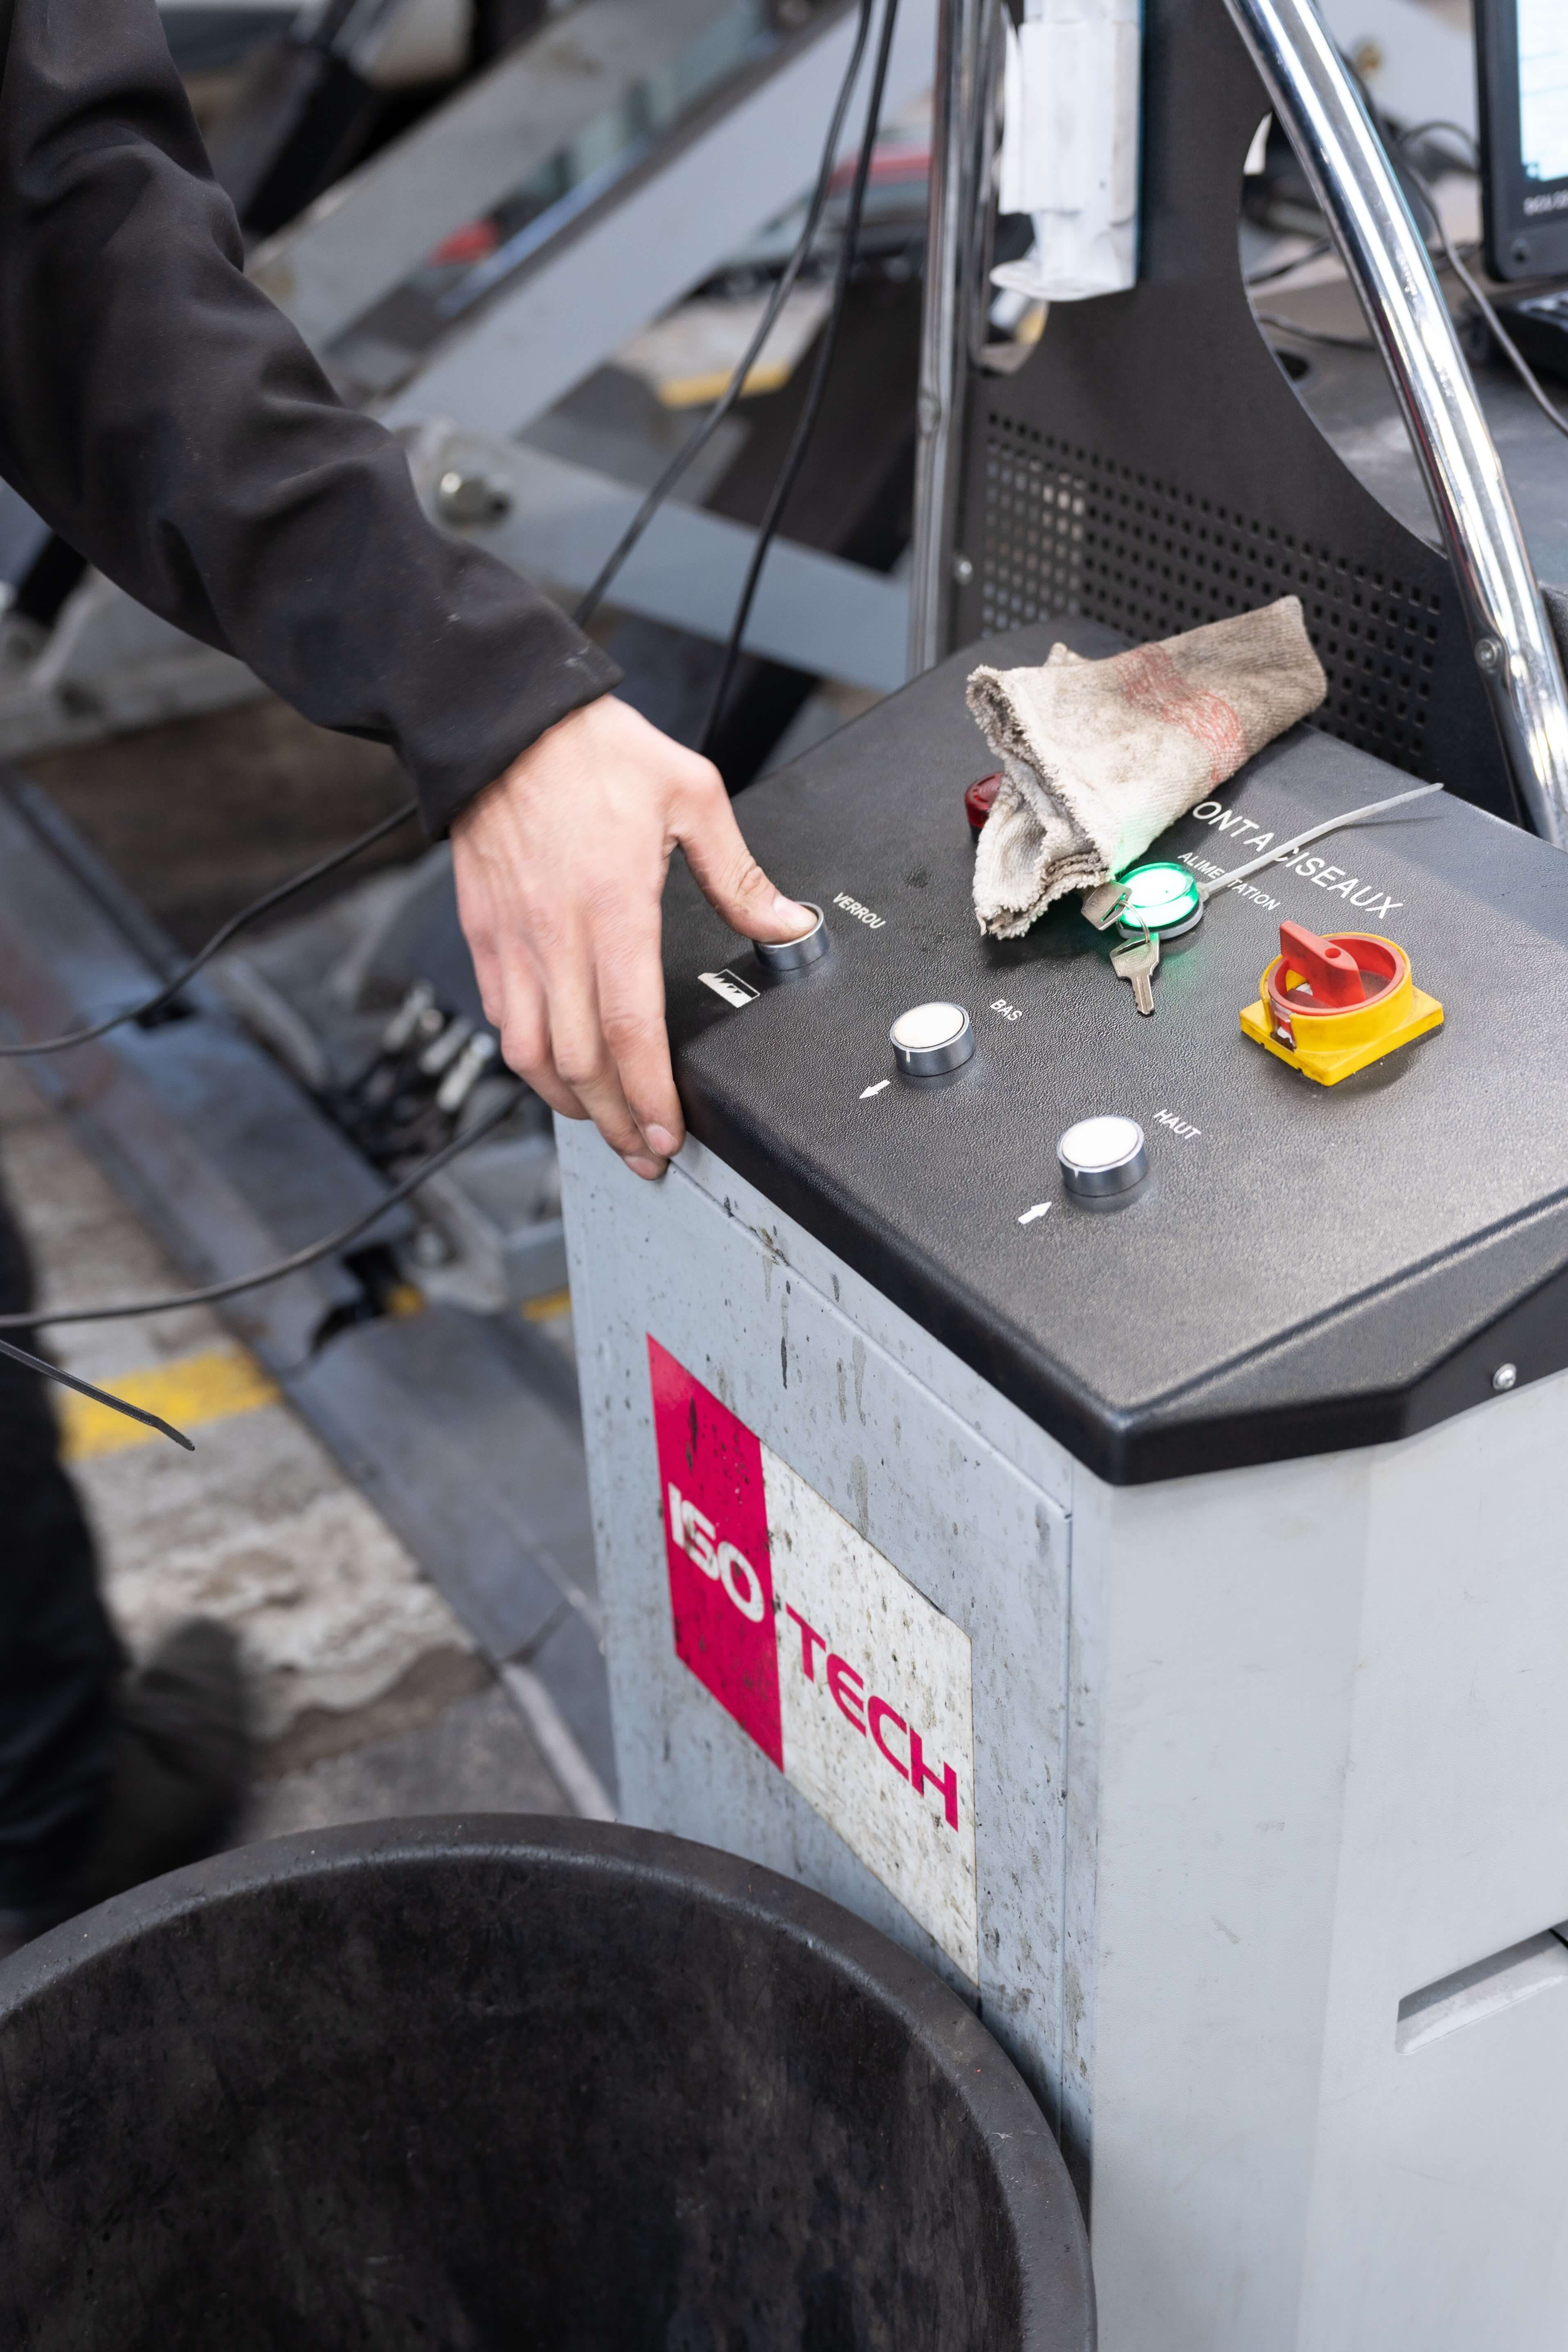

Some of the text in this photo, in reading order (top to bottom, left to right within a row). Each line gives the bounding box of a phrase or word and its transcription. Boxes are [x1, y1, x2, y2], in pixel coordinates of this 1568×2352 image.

[1193, 801, 1260, 837] ONT
[1177, 852, 1281, 911] ALIMETATION
[833, 892, 886, 929] VERROU
[990, 999, 1022, 1021] BAS
[1153, 1109, 1201, 1139] HAUT
[668, 1481, 959, 1833] ISO TECH
